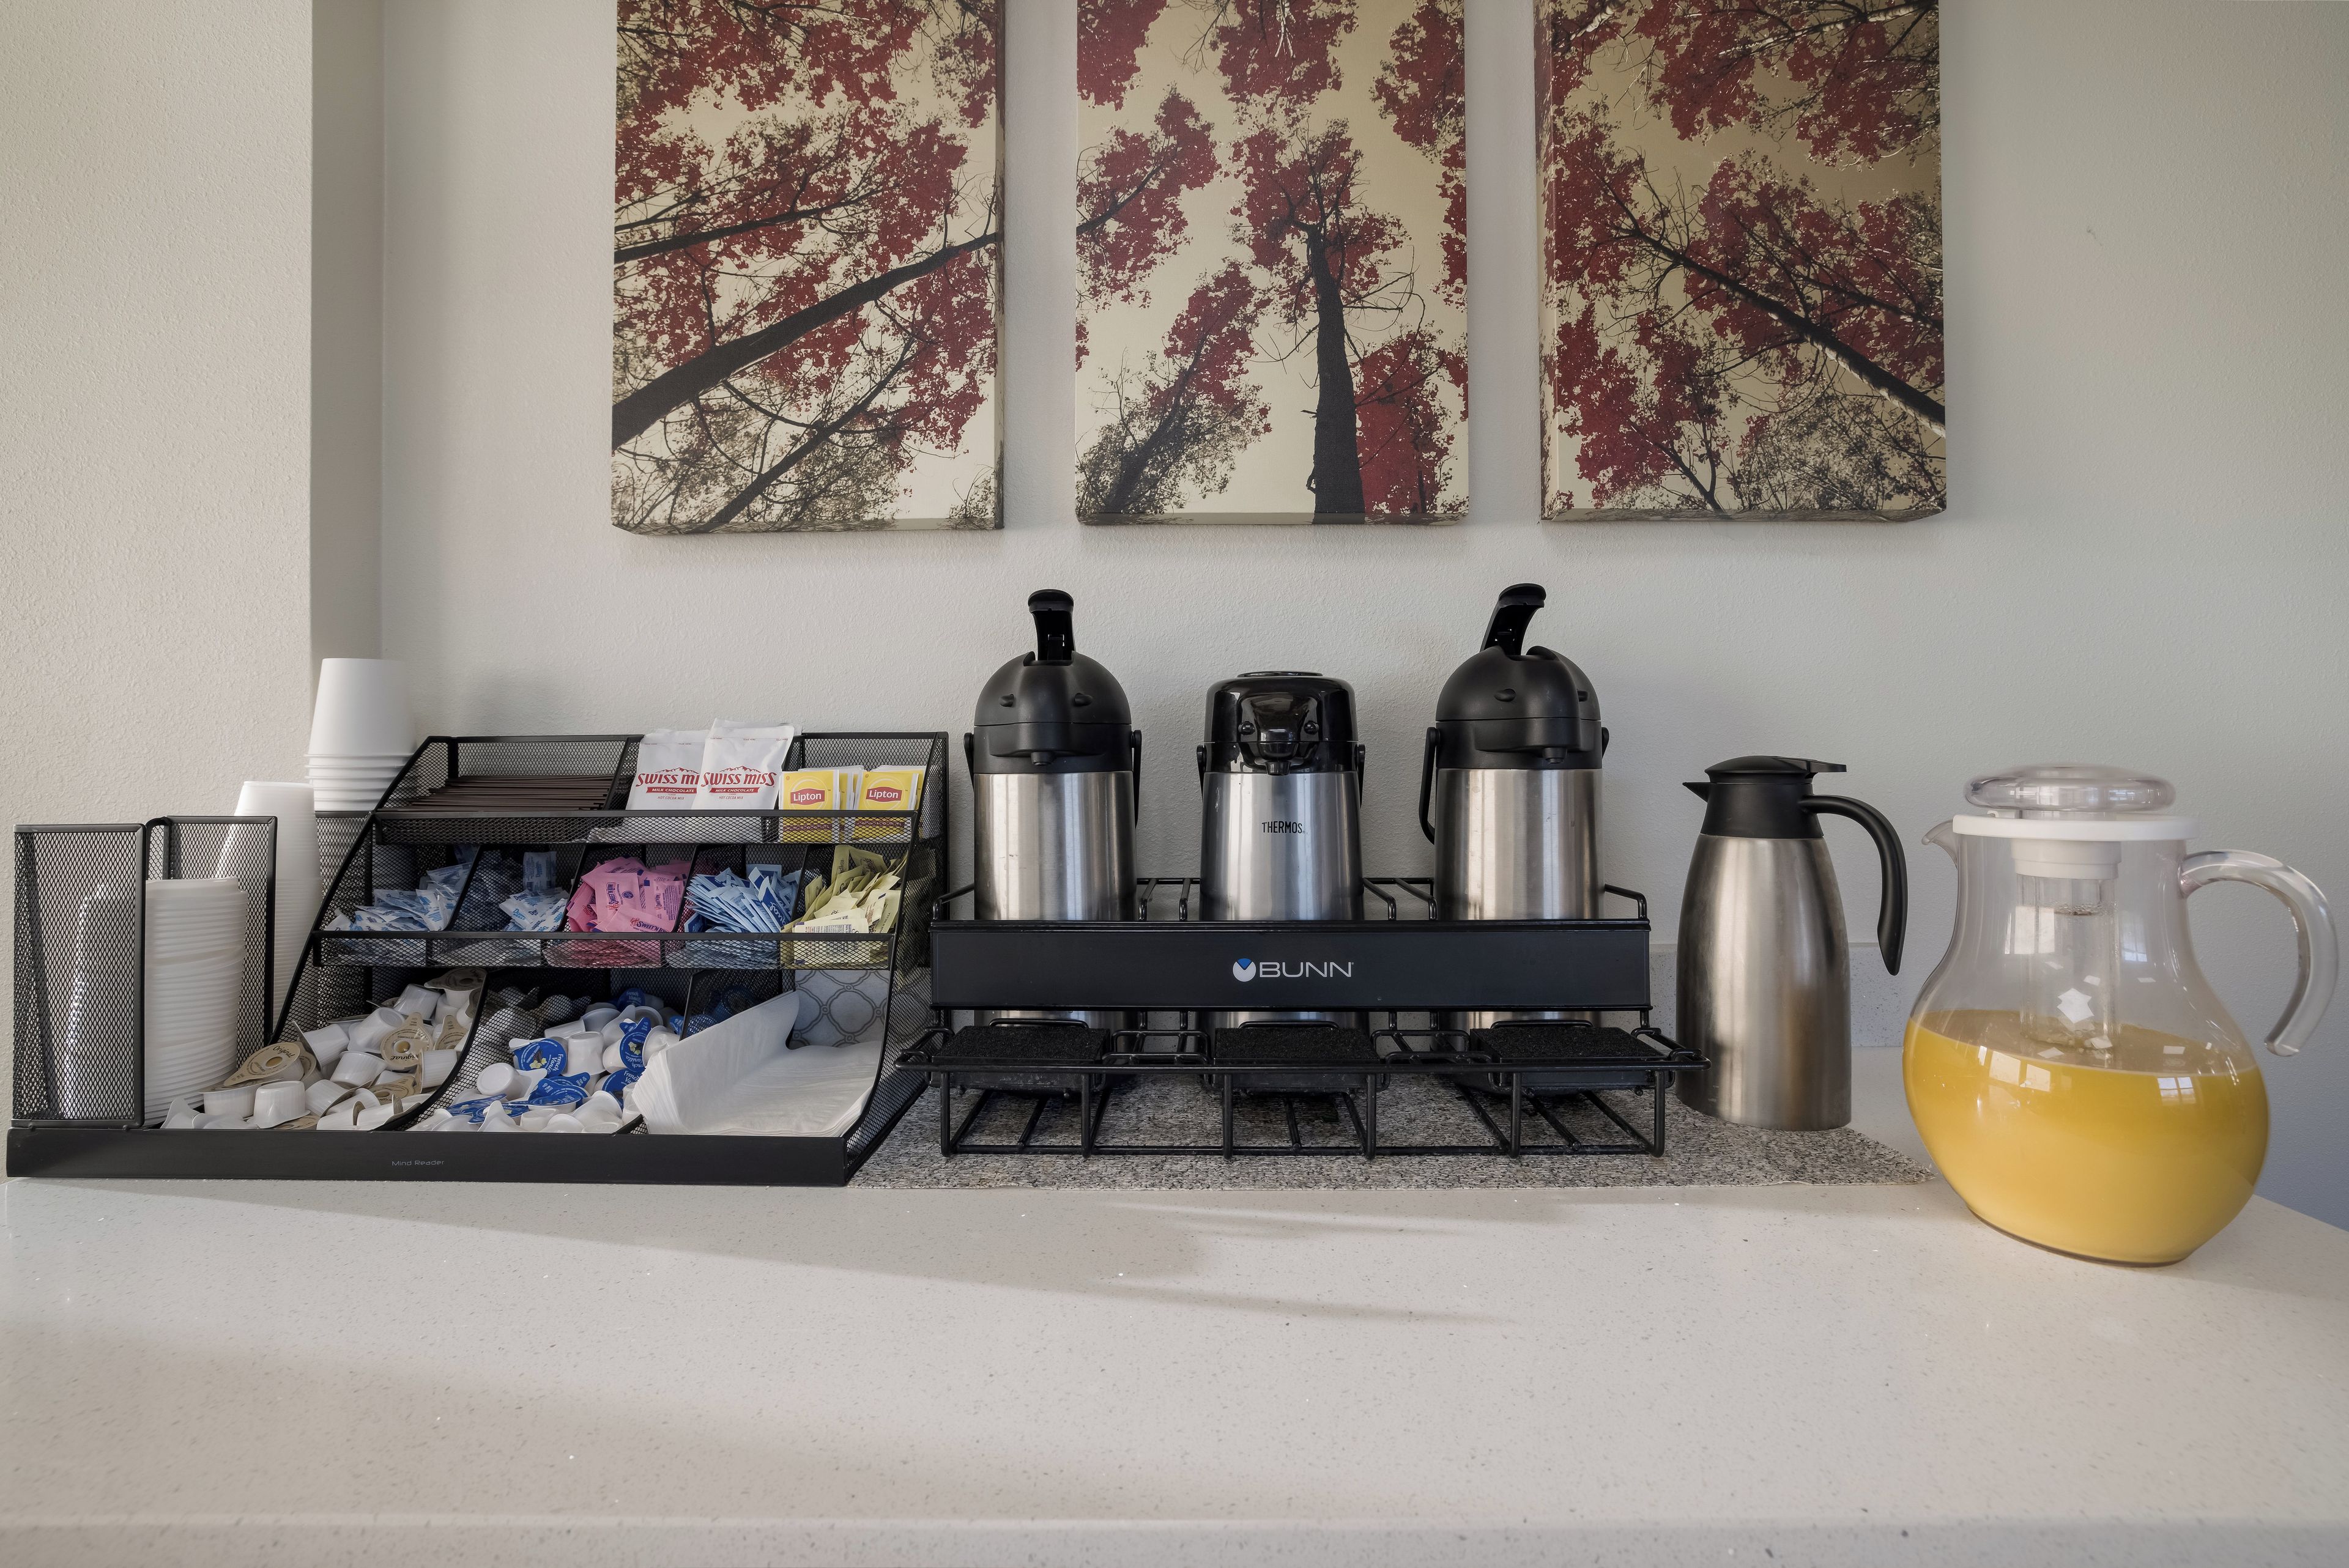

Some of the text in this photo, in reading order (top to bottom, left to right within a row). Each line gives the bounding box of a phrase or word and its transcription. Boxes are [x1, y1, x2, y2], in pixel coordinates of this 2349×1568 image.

[636, 773, 700, 787] SWISS MI
[700, 772, 777, 787] SWISS MISS
[793, 793, 822, 802] Lipton
[869, 790, 899, 799] Lipton
[1261, 821, 1303, 834] THERMOS
[1260, 962, 1351, 977] BUNN
[273, 1045, 295, 1059] Original
[547, 1057, 557, 1074] Vanil
[552, 1054, 563, 1071] French
